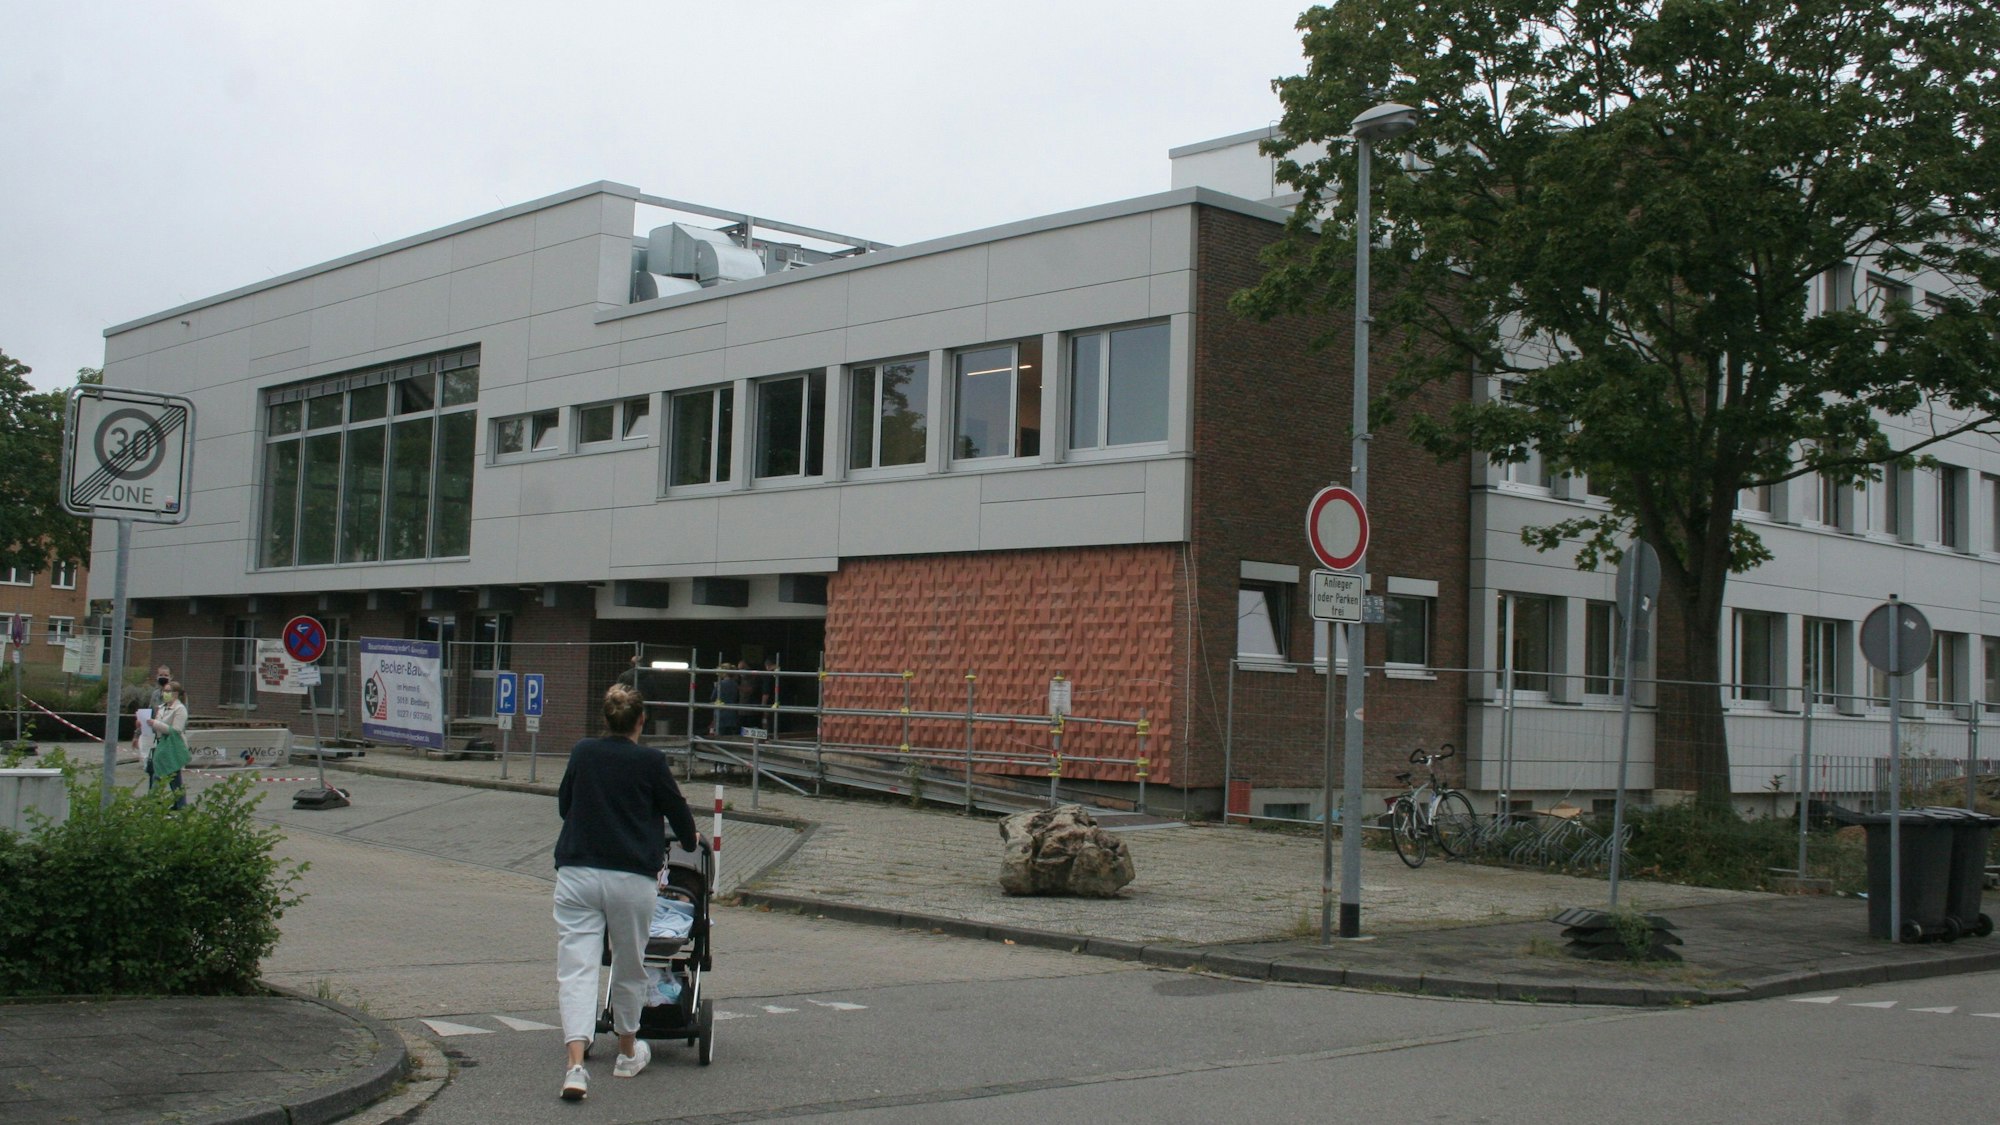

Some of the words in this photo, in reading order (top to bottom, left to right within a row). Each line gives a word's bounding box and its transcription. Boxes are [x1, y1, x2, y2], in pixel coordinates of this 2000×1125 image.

[110, 427, 151, 461] 30
[99, 484, 154, 504] ZONE
[1324, 577, 1353, 591] Anlieger
[1317, 592, 1333, 603] oder
[1336, 593, 1359, 605] Parken
[1332, 605, 1344, 616] frei
[500, 679, 512, 709] P
[528, 679, 539, 710] P
[248, 746, 284, 757] WeGo
